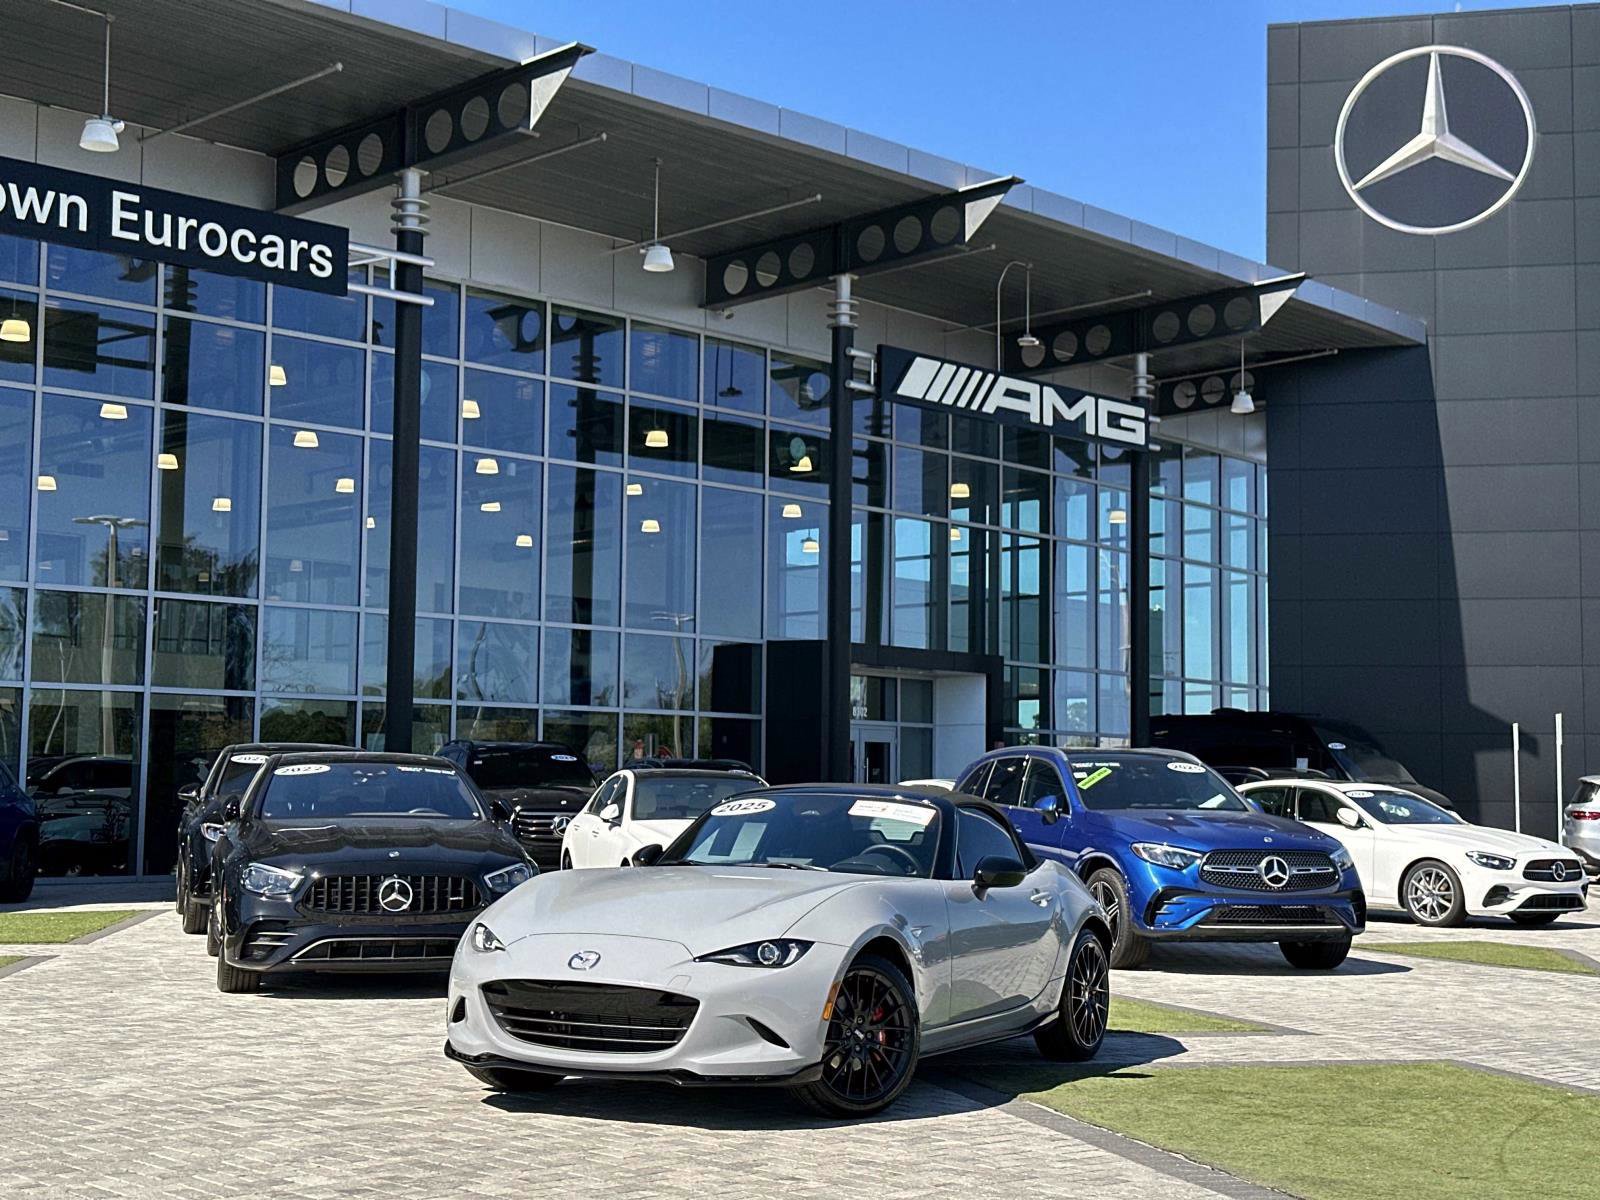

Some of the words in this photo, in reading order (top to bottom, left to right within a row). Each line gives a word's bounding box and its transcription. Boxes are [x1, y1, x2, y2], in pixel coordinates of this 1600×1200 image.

[0, 182, 88, 232] wn
[111, 190, 333, 278] Eurocars
[981, 375, 1146, 446] AMG
[716, 802, 769, 813] 2025
